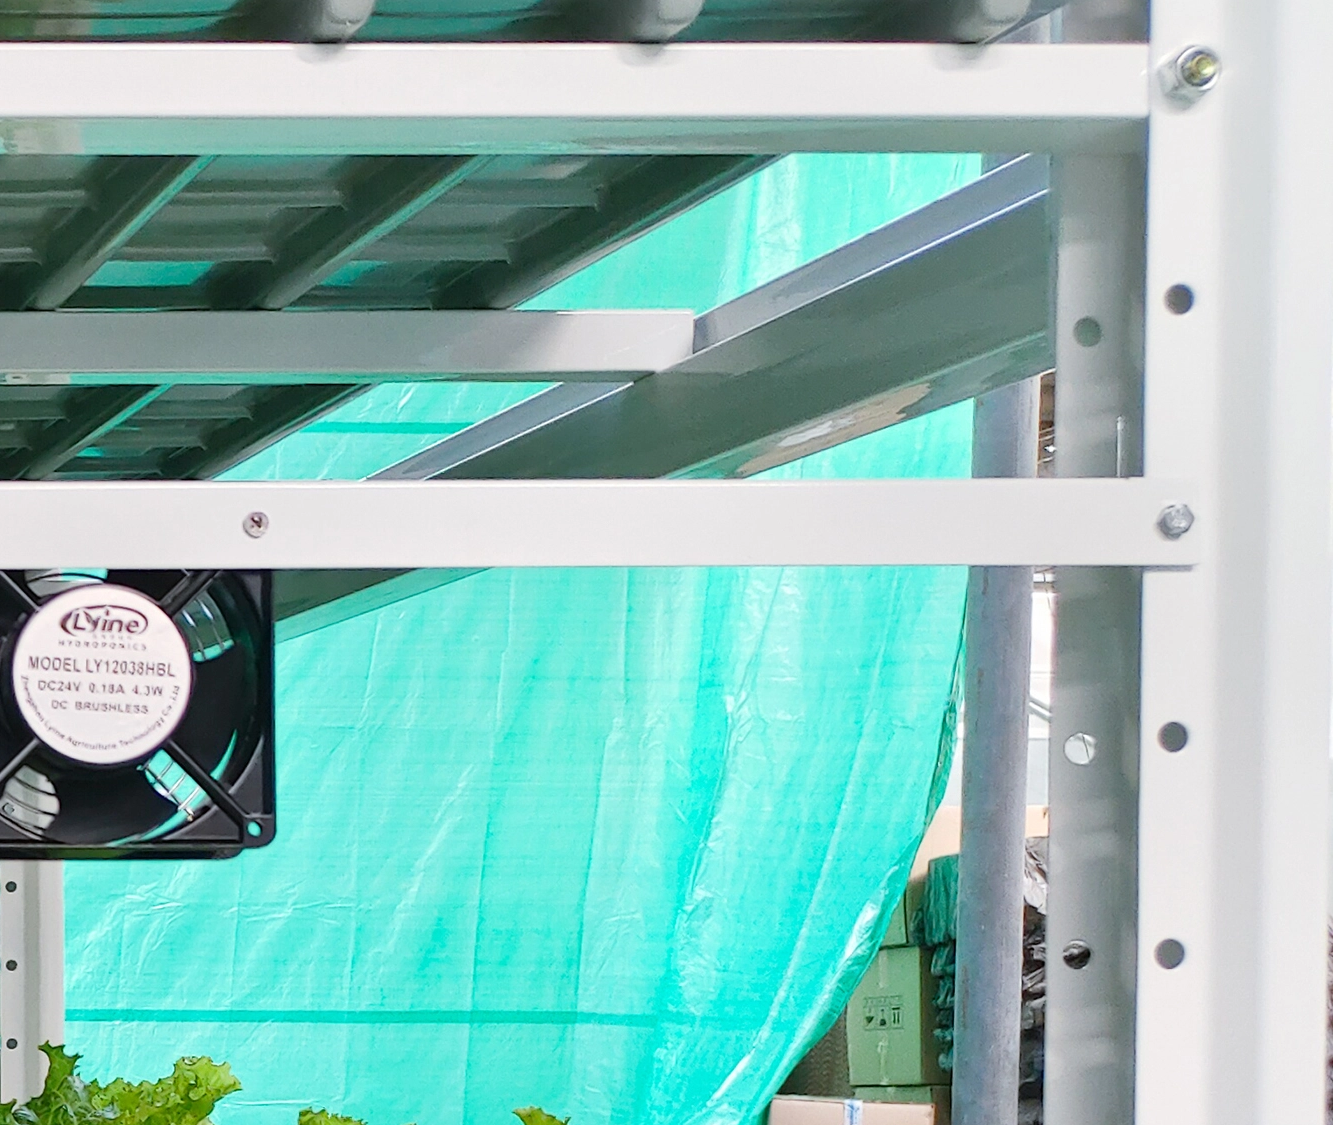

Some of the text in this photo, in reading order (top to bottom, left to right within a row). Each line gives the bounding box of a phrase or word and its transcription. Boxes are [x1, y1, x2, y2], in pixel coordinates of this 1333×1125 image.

[72, 608, 140, 633] Lyine
[28, 655, 81, 673] MODEL
[37, 680, 81, 692] DC24V
[51, 699, 149, 714] DC BRUSHLESS
